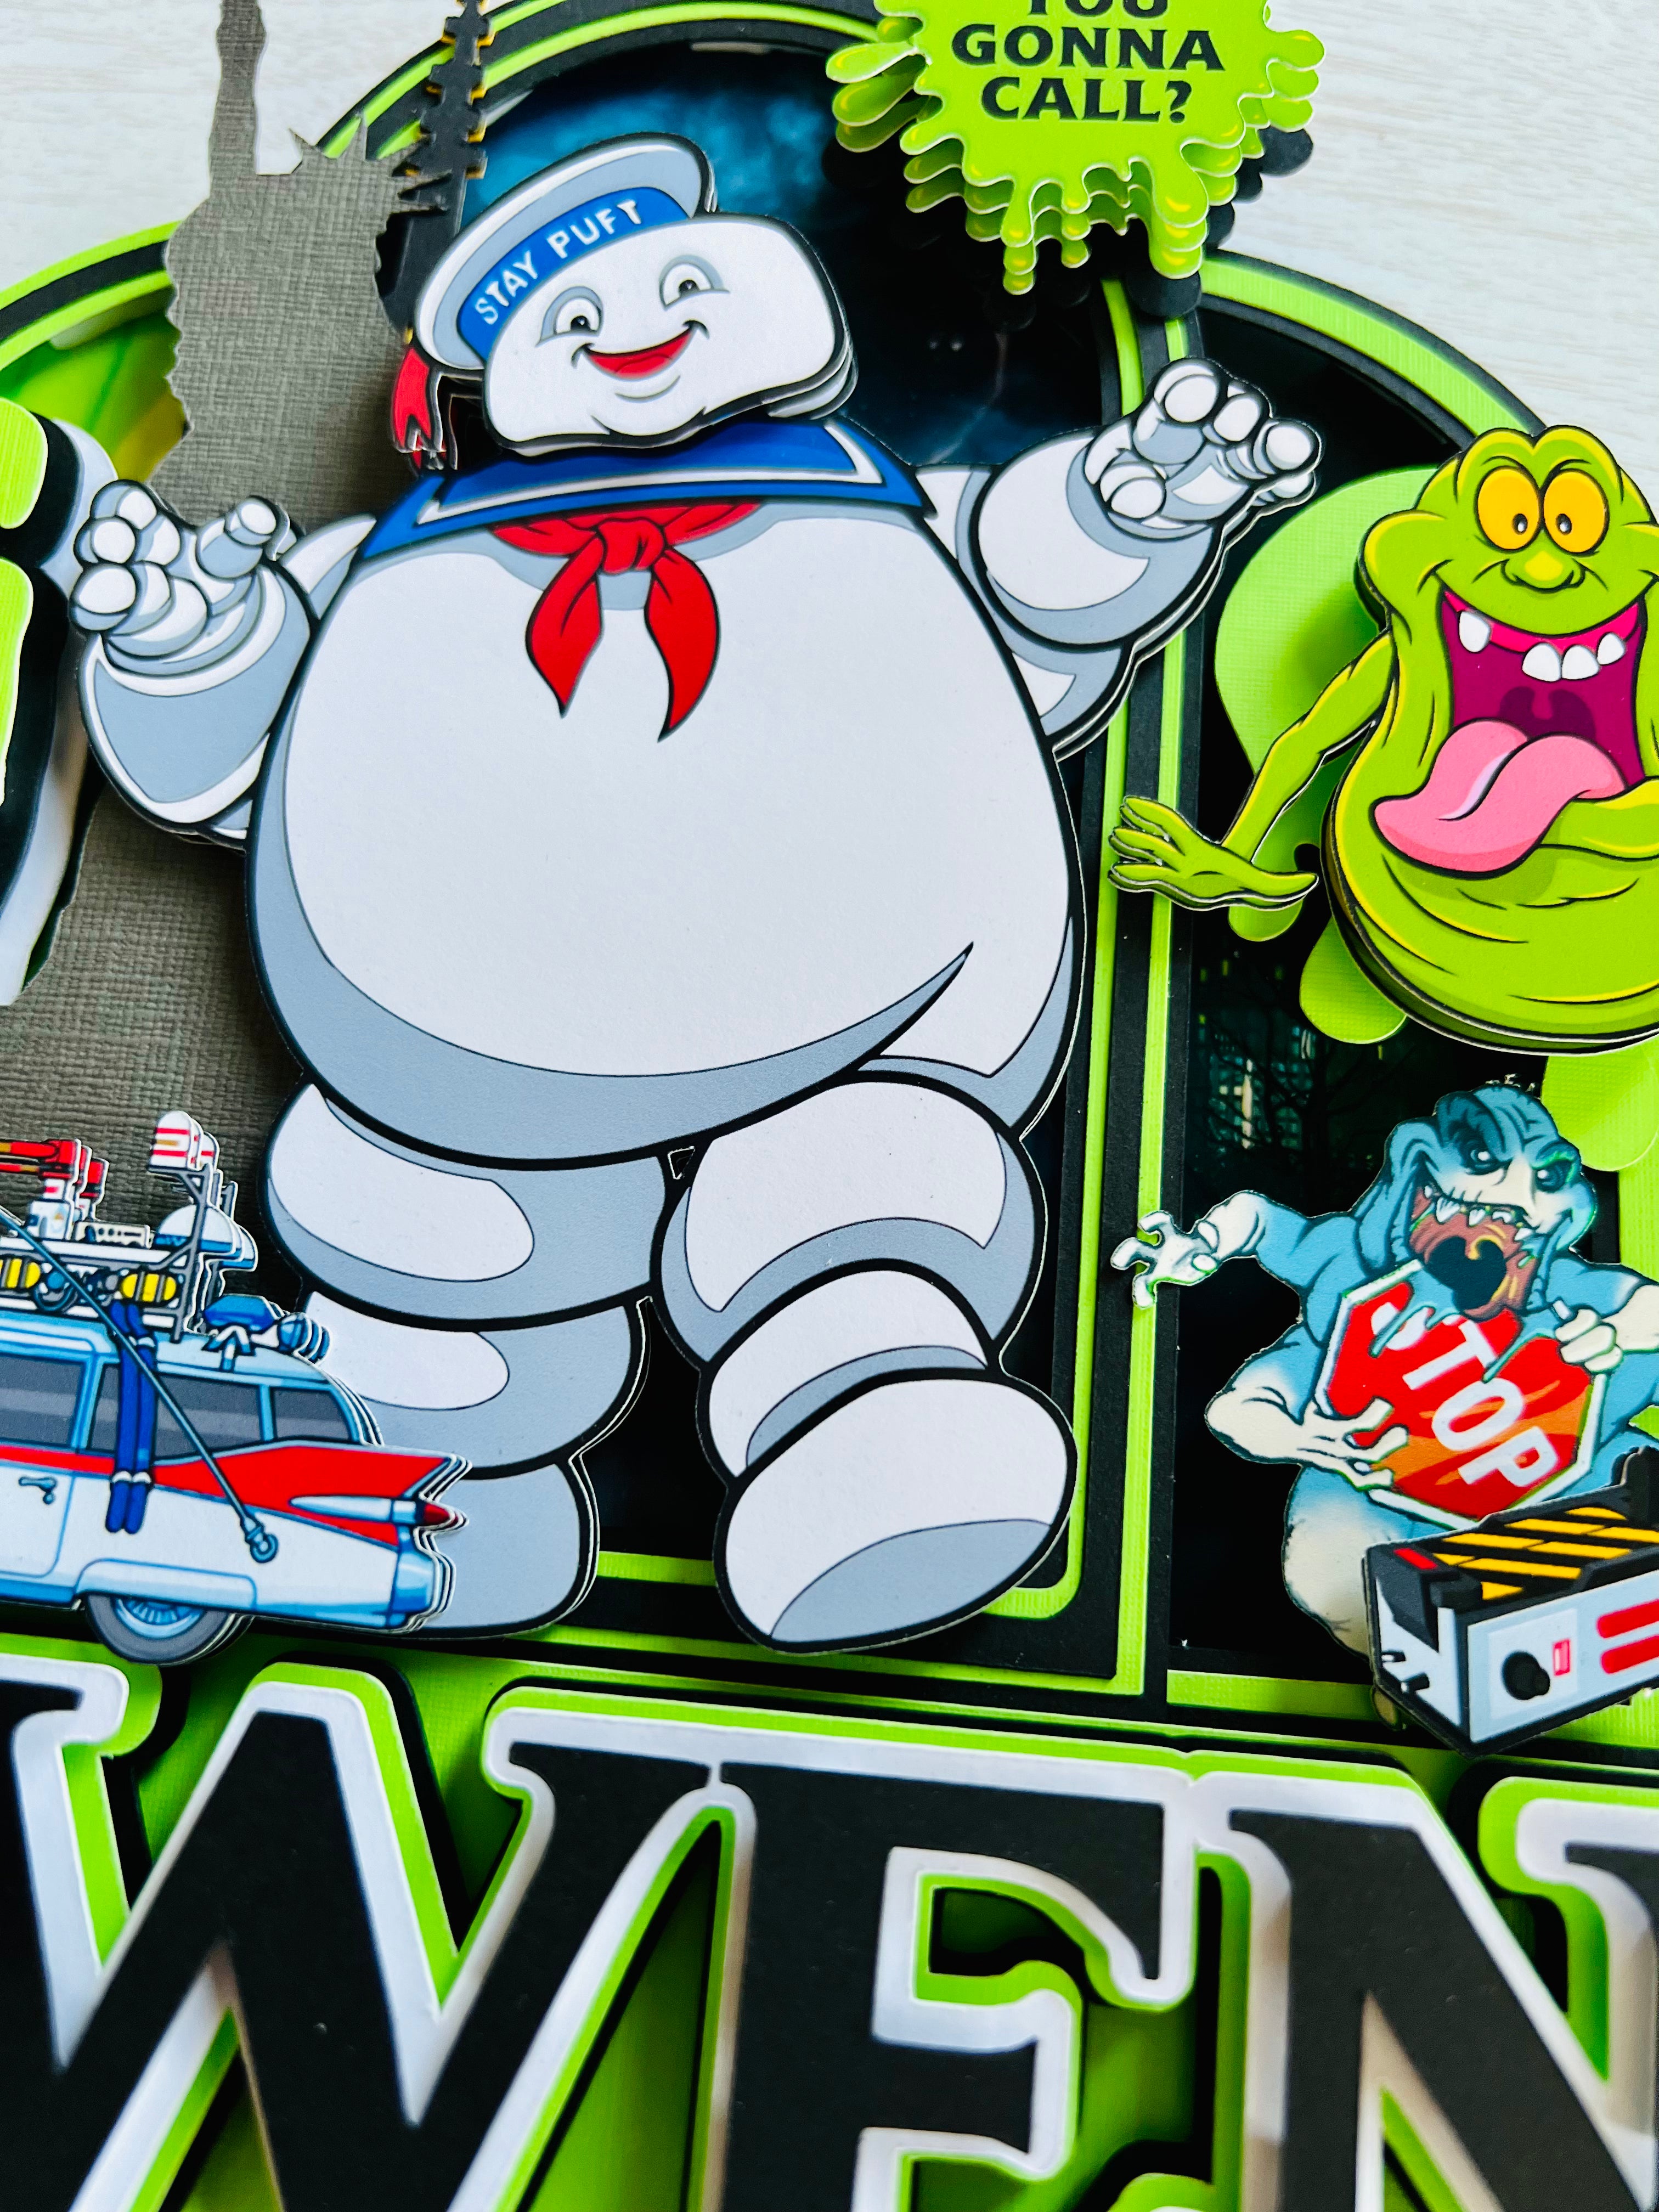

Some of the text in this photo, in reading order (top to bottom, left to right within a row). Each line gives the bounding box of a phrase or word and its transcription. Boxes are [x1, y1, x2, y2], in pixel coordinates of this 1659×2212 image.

[951, 23, 1226, 71] GONNA
[981, 76, 1192, 123] CALL?
[475, 199, 642, 325] STAY PUFT
[1371, 1301, 1560, 1488] STOP
